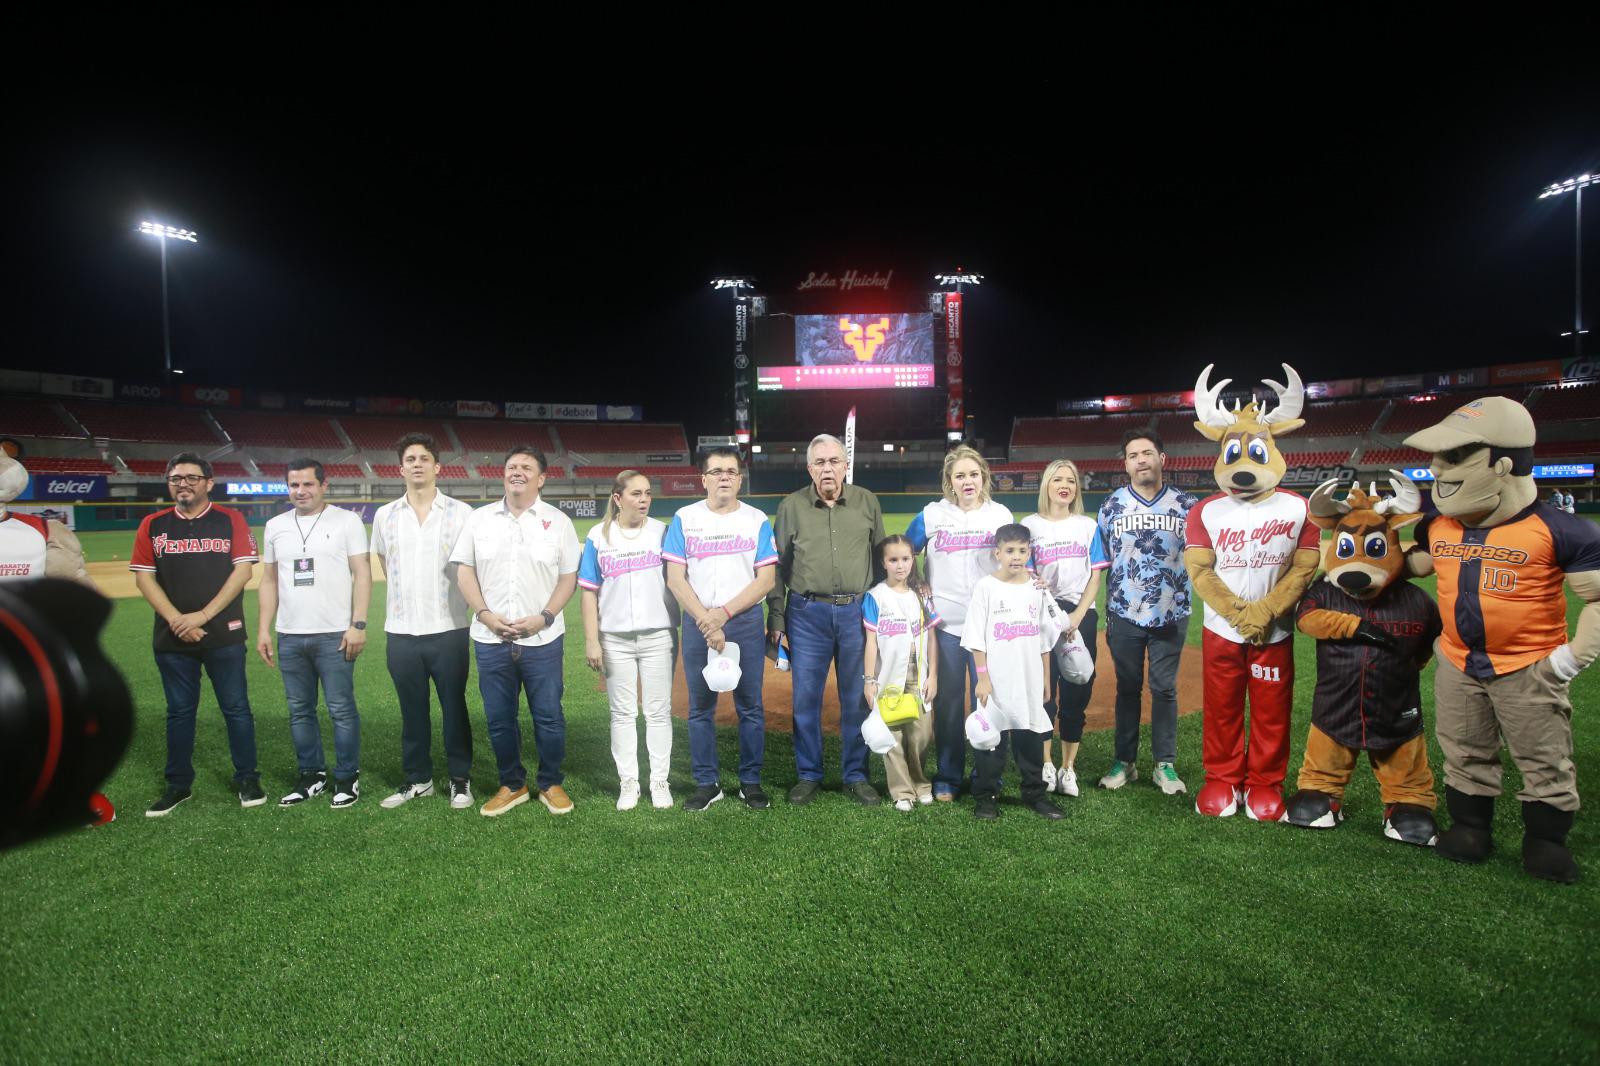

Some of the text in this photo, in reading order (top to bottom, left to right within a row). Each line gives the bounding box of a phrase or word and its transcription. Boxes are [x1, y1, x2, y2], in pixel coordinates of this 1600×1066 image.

[840, 269, 893, 290] Huichol
[121, 385, 160, 398] ARCO
[47, 480, 95, 493] telcel
[227, 483, 263, 493] BAR
[560, 500, 596, 509] POWER
[576, 508, 597, 517] ADE
[1113, 514, 1185, 539] GUASAVE
[686, 534, 756, 555] Bienestar
[1432, 540, 1529, 565] Gaspasa
[1483, 566, 1517, 591] 10
